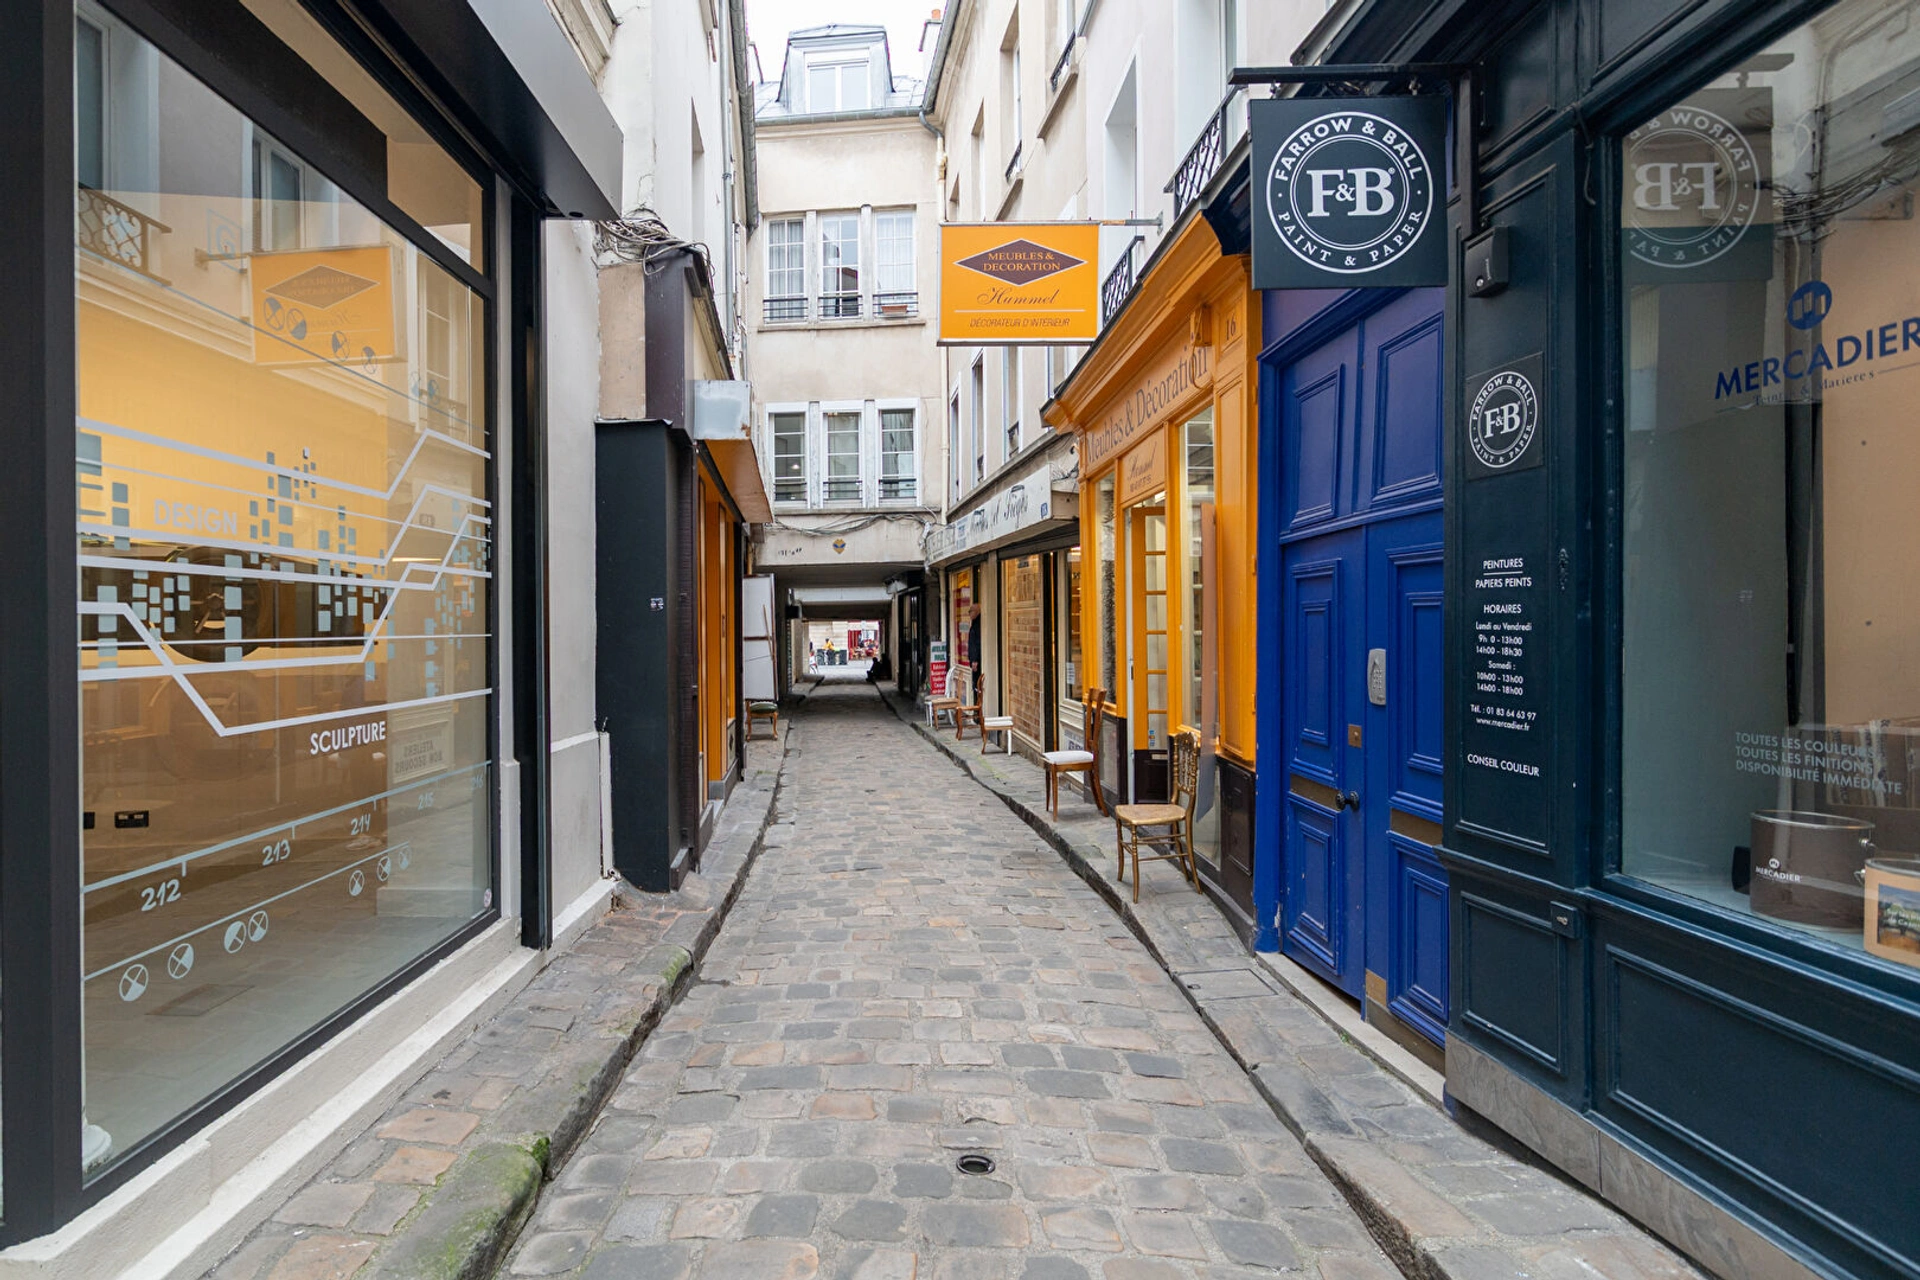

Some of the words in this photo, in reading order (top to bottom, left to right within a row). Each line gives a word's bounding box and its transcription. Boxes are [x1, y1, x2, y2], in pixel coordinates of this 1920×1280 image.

[1275, 117, 1352, 181] FARROW
[1362, 120, 1376, 136] &
[1382, 129, 1423, 180] BALL
[1306, 167, 1395, 217] F&B
[1278, 211, 1331, 262] PAINT
[1344, 256, 1356, 266] &
[1369, 211, 1423, 262] PAPER
[983, 261, 1060, 272] DECORATION
[988, 252, 1043, 261] MEUBLES
[1045, 252, 1055, 260] &
[977, 286, 1060, 305] Hummel
[1226, 318, 1236, 341] 16
[1715, 316, 1920, 400] MERCADIER
[1087, 417, 1123, 464] Meubles
[1125, 402, 1134, 437] &
[1136, 345, 1208, 428] Décoration
[1472, 375, 1503, 420] FARROW
[1507, 375, 1513, 384] &
[1515, 379, 1533, 406] BALL
[1484, 402, 1520, 439] F&B
[1473, 437, 1494, 463] PAINT
[1509, 424, 1533, 459] PAPER
[154, 498, 237, 536] DESIGN
[1483, 558, 1523, 569] PEINTURES
[1475, 578, 1503, 588] PAPIERS
[1504, 577, 1532, 587] PEINTS
[1483, 604, 1522, 613] HORAIRES
[1475, 621, 1492, 630] Lundi
[1502, 622, 1532, 631] Vendredi
[1476, 645, 1495, 655] 14h00
[1501, 646, 1523, 657] 18h30
[1501, 636, 1523, 645] 13h00
[1488, 660, 1512, 670] Samedi
[1476, 672, 1496, 682] 10h00
[1502, 674, 1524, 684] 13h00
[1476, 683, 1496, 693] 14h00
[1502, 685, 1523, 696] 18h00
[1476, 717, 1530, 731] www.mercadier.fr
[1486, 706, 1494, 715] 01
[1496, 708, 1504, 717] 83
[1506, 709, 1515, 718] 64
[1516, 711, 1525, 720] 63
[1526, 712, 1537, 721] 97
[310, 720, 386, 755] SCULPTURE
[1735, 732, 1778, 747] TOUTES
[1781, 736, 1801, 750] LES
[1804, 739, 1876, 759] COULEURS
[1467, 754, 1499, 769] CONSEIL
[1500, 760, 1540, 777] COULEUR
[1735, 746, 1778, 761] TOUTES
[1781, 751, 1801, 764] LES
[1804, 754, 1873, 774] FINITIONS
[1735, 760, 1820, 782] DISPONIBILITÉ
[1823, 772, 1903, 796] IMMÉDIATE
[418, 792, 434, 810] 215
[351, 813, 371, 836] 214
[262, 838, 291, 867] 213
[1755, 865, 1801, 883] MERCADIER
[140, 879, 181, 911] 212
